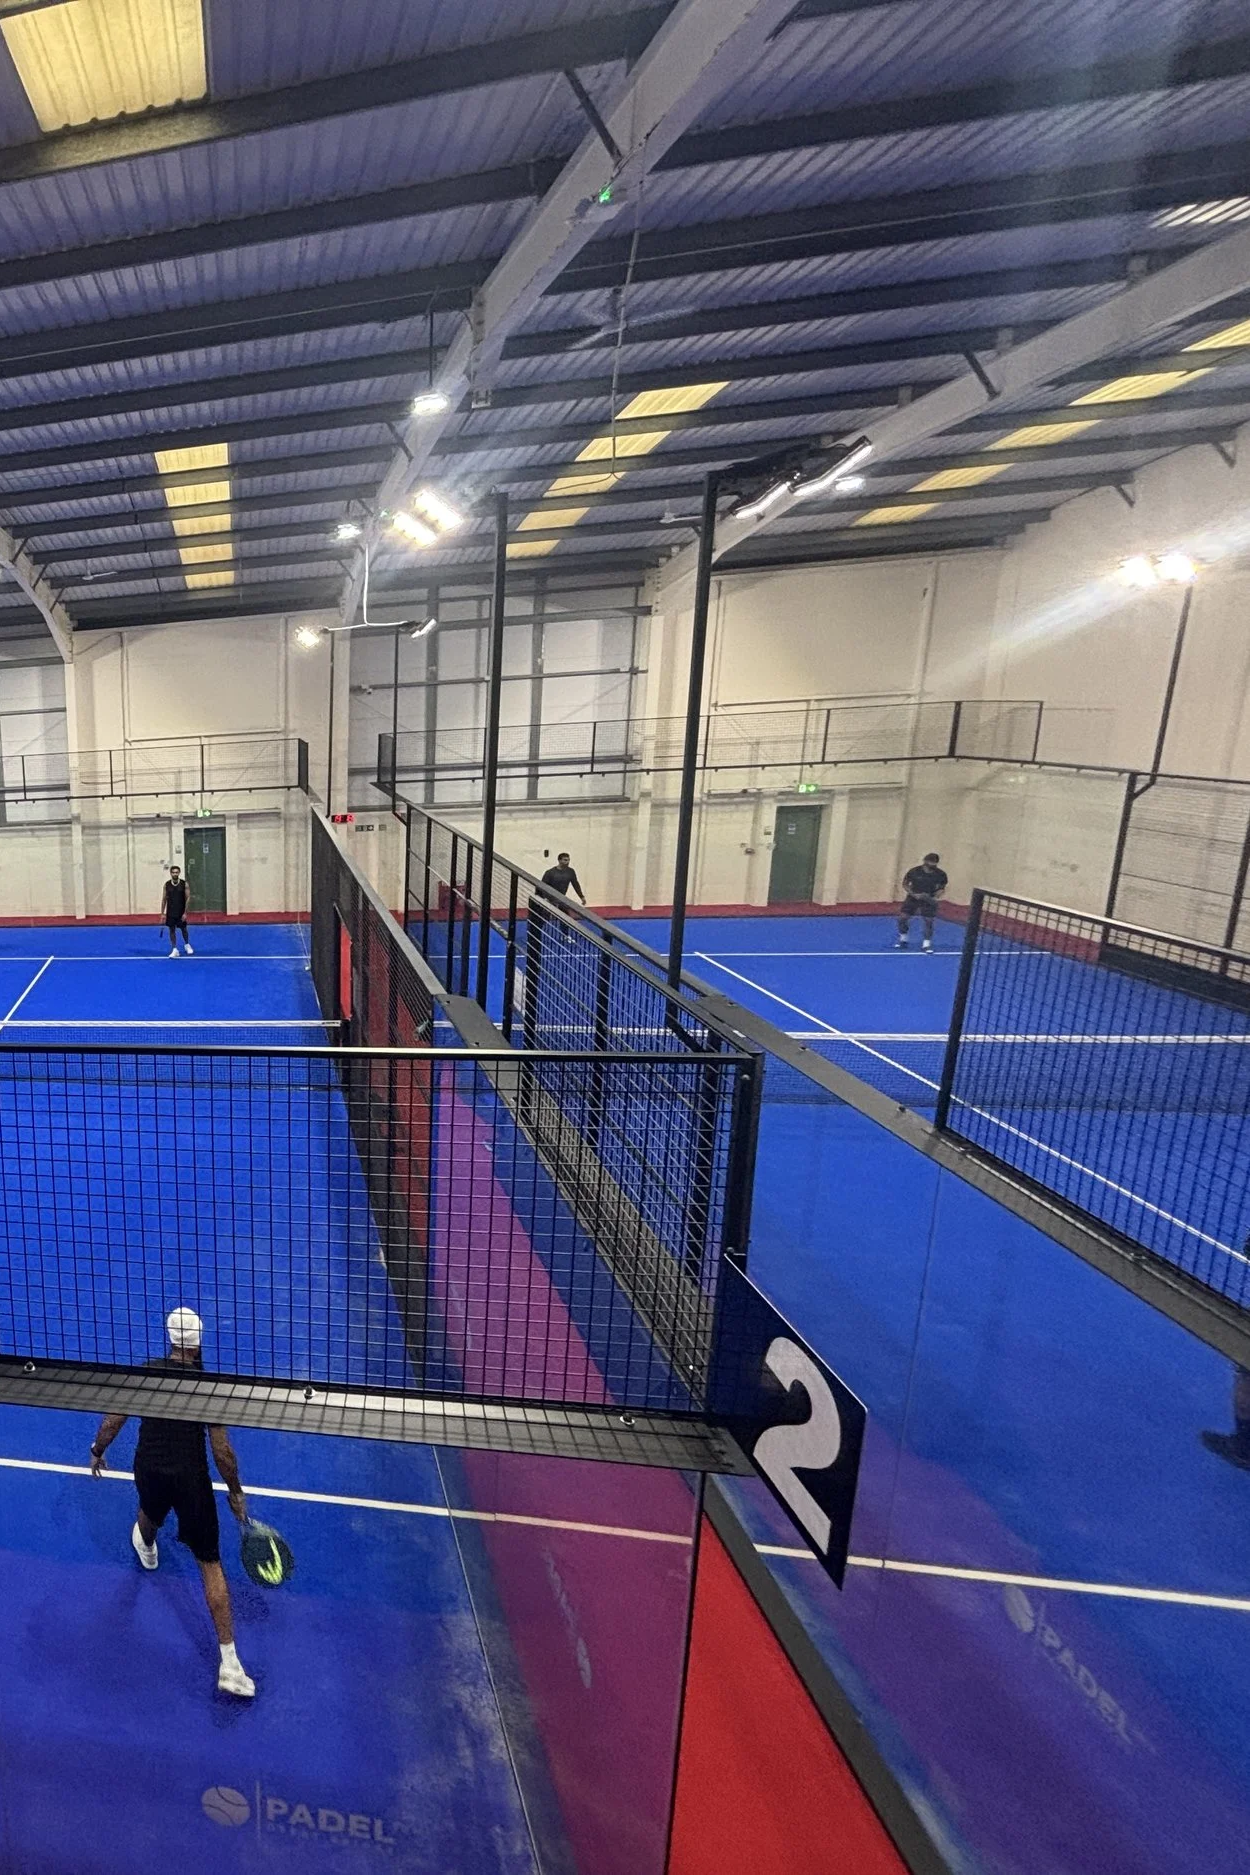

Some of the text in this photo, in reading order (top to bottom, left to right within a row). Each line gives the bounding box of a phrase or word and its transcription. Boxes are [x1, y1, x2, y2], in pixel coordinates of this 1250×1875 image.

[753, 1336, 842, 1556] 2
[1040, 1623, 1133, 1745] PADEL
[266, 1797, 396, 1844] PADEL
